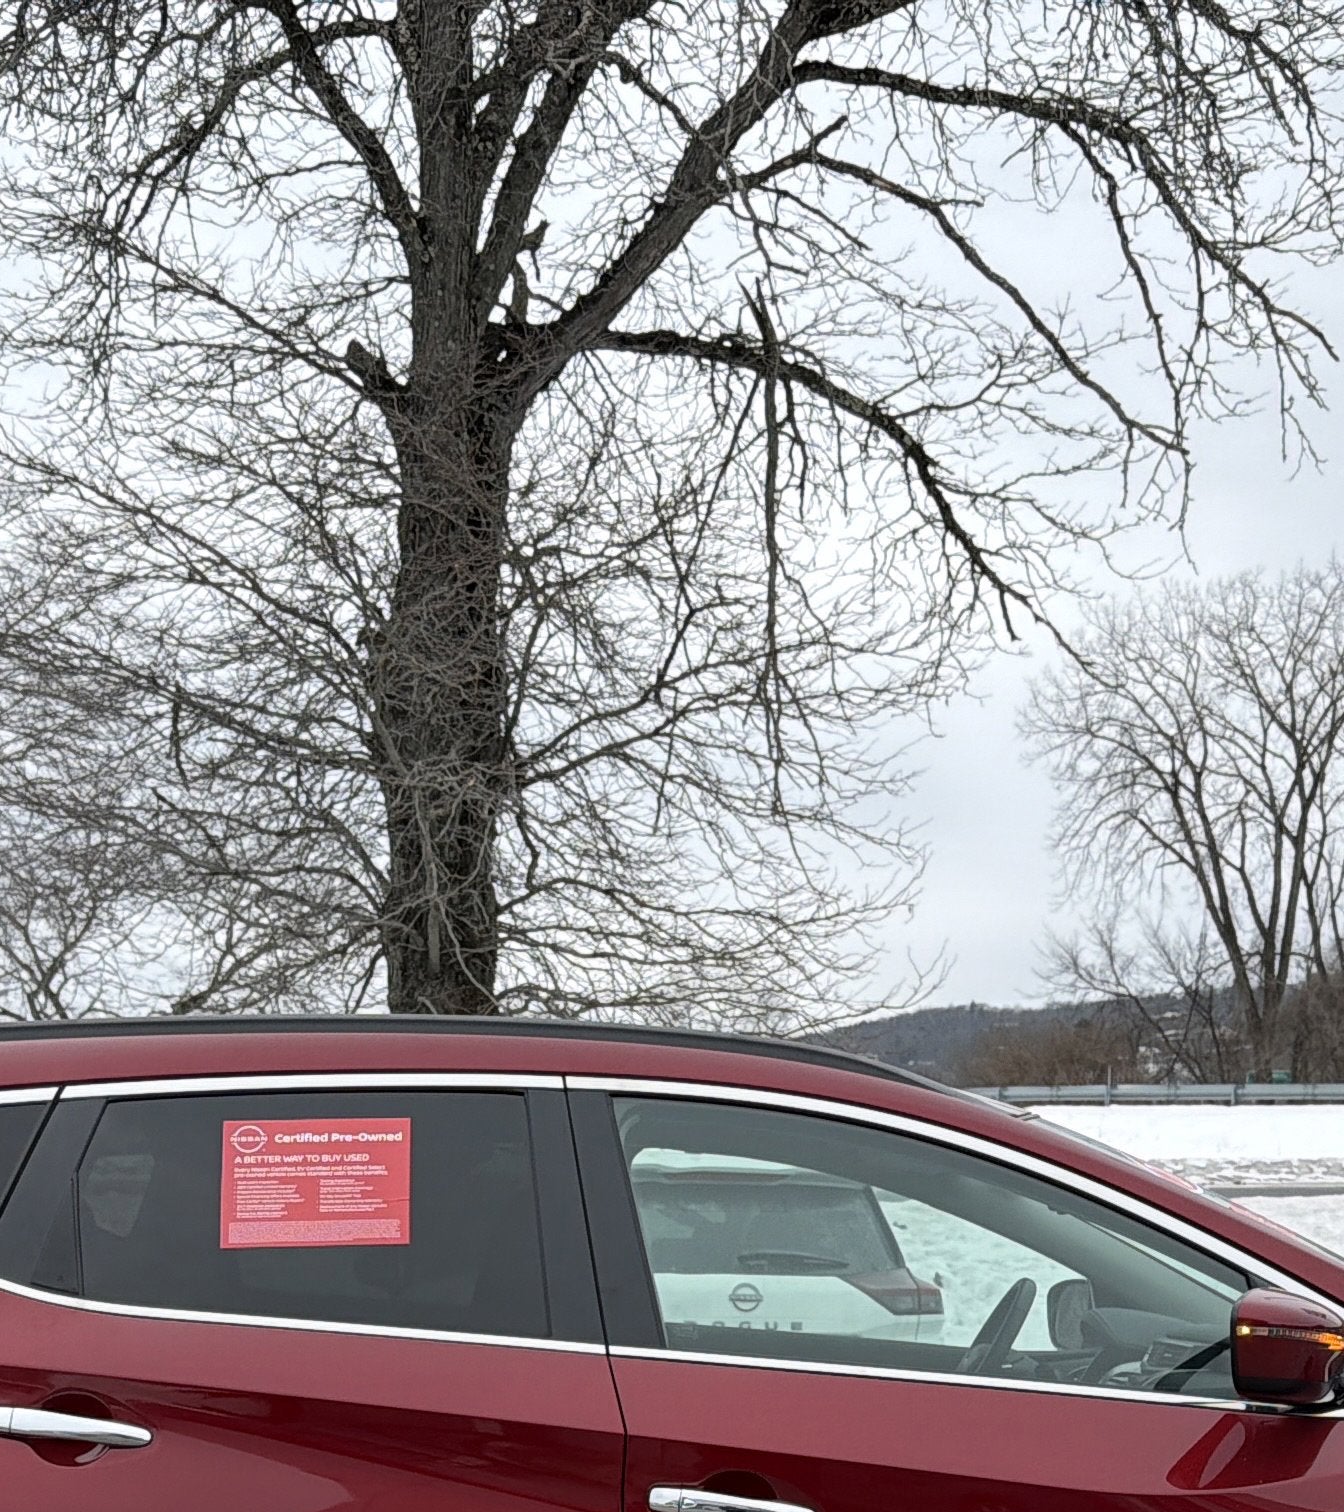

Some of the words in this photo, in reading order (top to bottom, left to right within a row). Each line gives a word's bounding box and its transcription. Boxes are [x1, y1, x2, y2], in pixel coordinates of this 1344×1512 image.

[274, 1132, 329, 1144] Certified
[331, 1130, 403, 1143] Pre-Owned
[234, 1156, 242, 1164] A
[243, 1155, 281, 1164] BETTER
[282, 1154, 304, 1163] WAY
[305, 1154, 320, 1163] TO
[321, 1153, 343, 1163] BUY
[343, 1153, 370, 1162] USED
